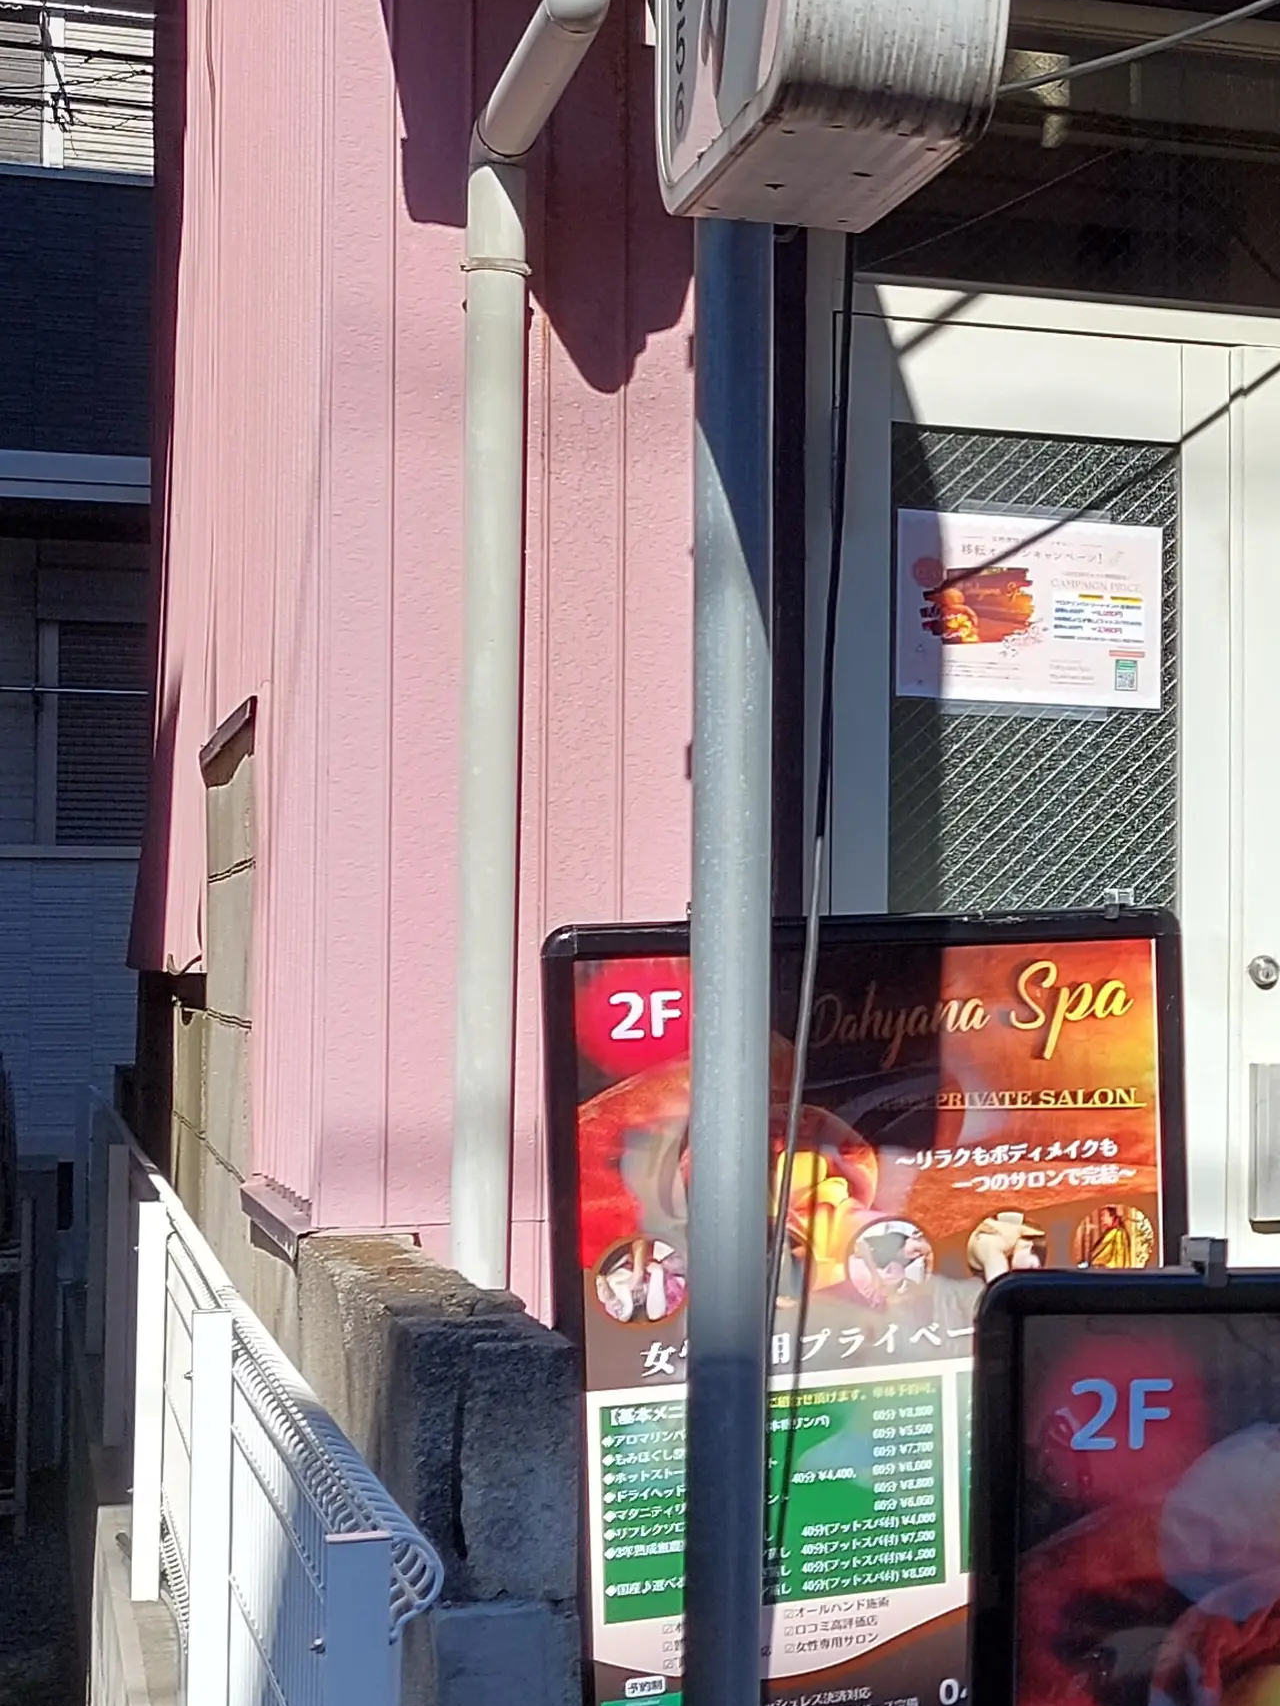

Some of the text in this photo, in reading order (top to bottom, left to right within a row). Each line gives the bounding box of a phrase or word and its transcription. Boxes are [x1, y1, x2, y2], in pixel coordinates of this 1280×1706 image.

[1051, 578, 1107, 591] CAMPAIGN
[608, 991, 683, 1041] 2F
[804, 960, 1134, 1070] Dahyana Spa
[936, 1091, 1032, 1109] PRIVATE
[1038, 1087, 1138, 1107] SALON
[640, 1323, 974, 1378] 女用プライベー
[1069, 1378, 1175, 1451] 2F
[794, 1596, 889, 1618] オールハンド施術
[794, 1615, 878, 1636] 口コミ高評価店
[794, 1632, 879, 1653] 女性専用サロン
